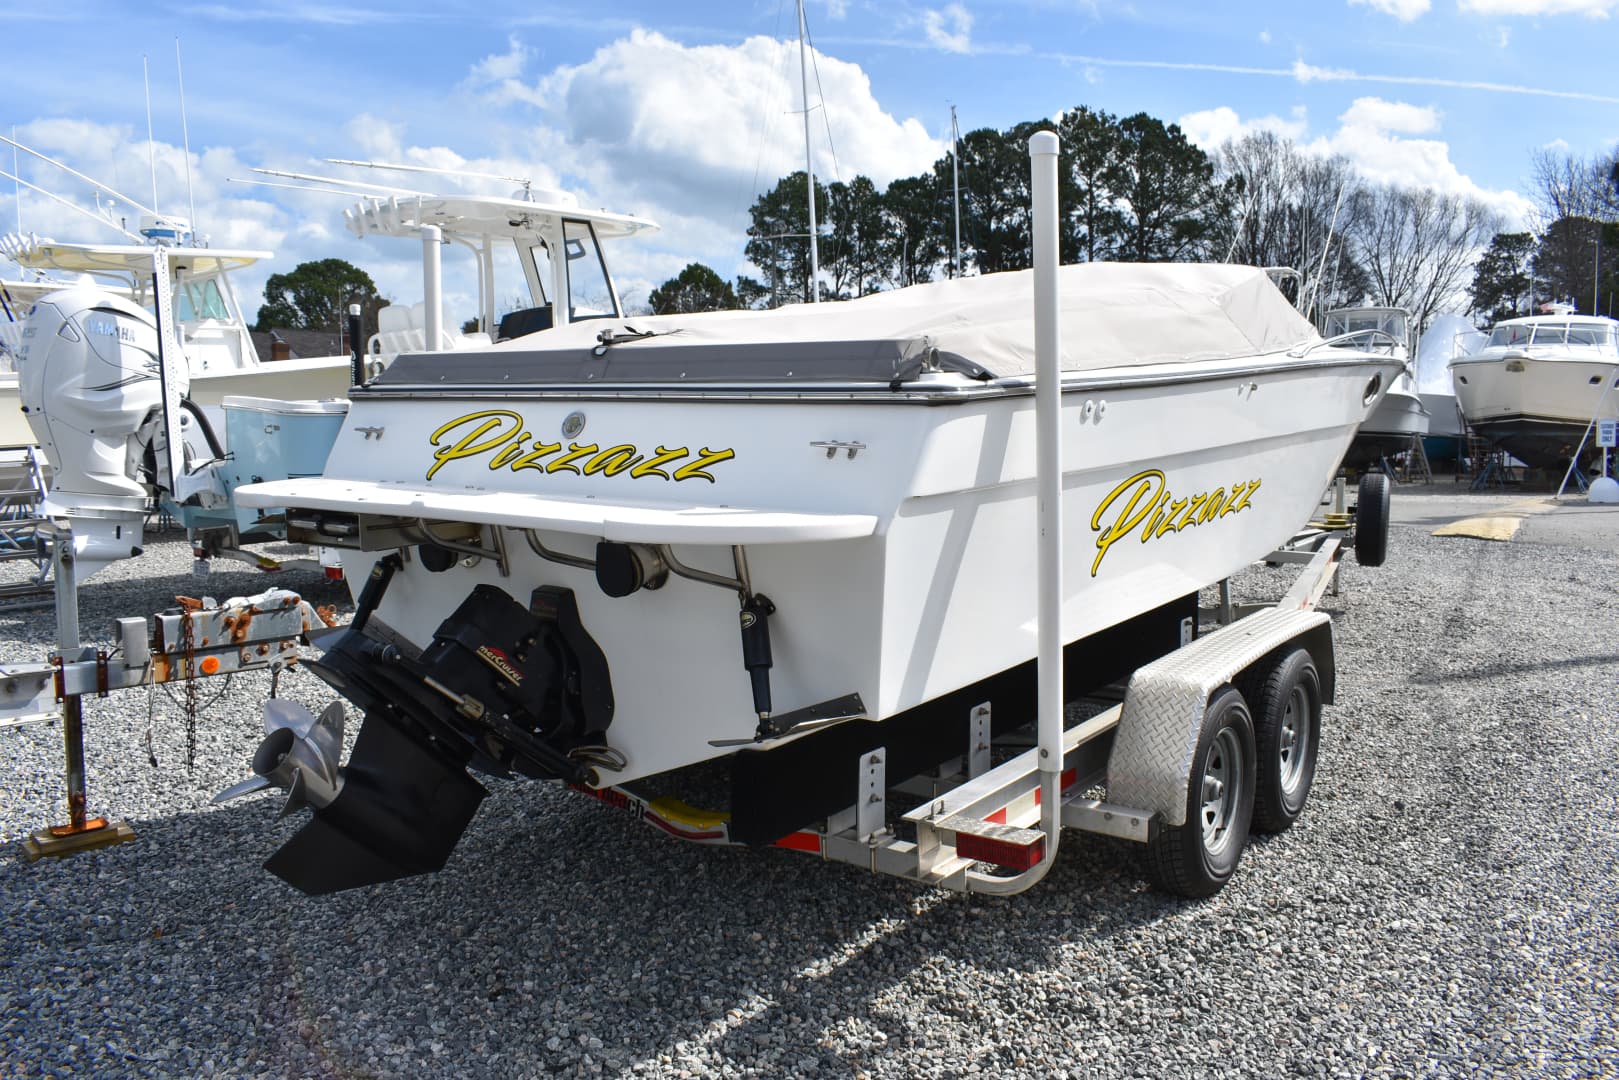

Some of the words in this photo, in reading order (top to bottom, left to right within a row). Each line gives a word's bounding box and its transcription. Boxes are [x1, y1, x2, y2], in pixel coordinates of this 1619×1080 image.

[88, 319, 136, 342] YAMAHA
[426, 409, 735, 483] Pizzazz
[1091, 468, 1262, 577] Pizzazz
